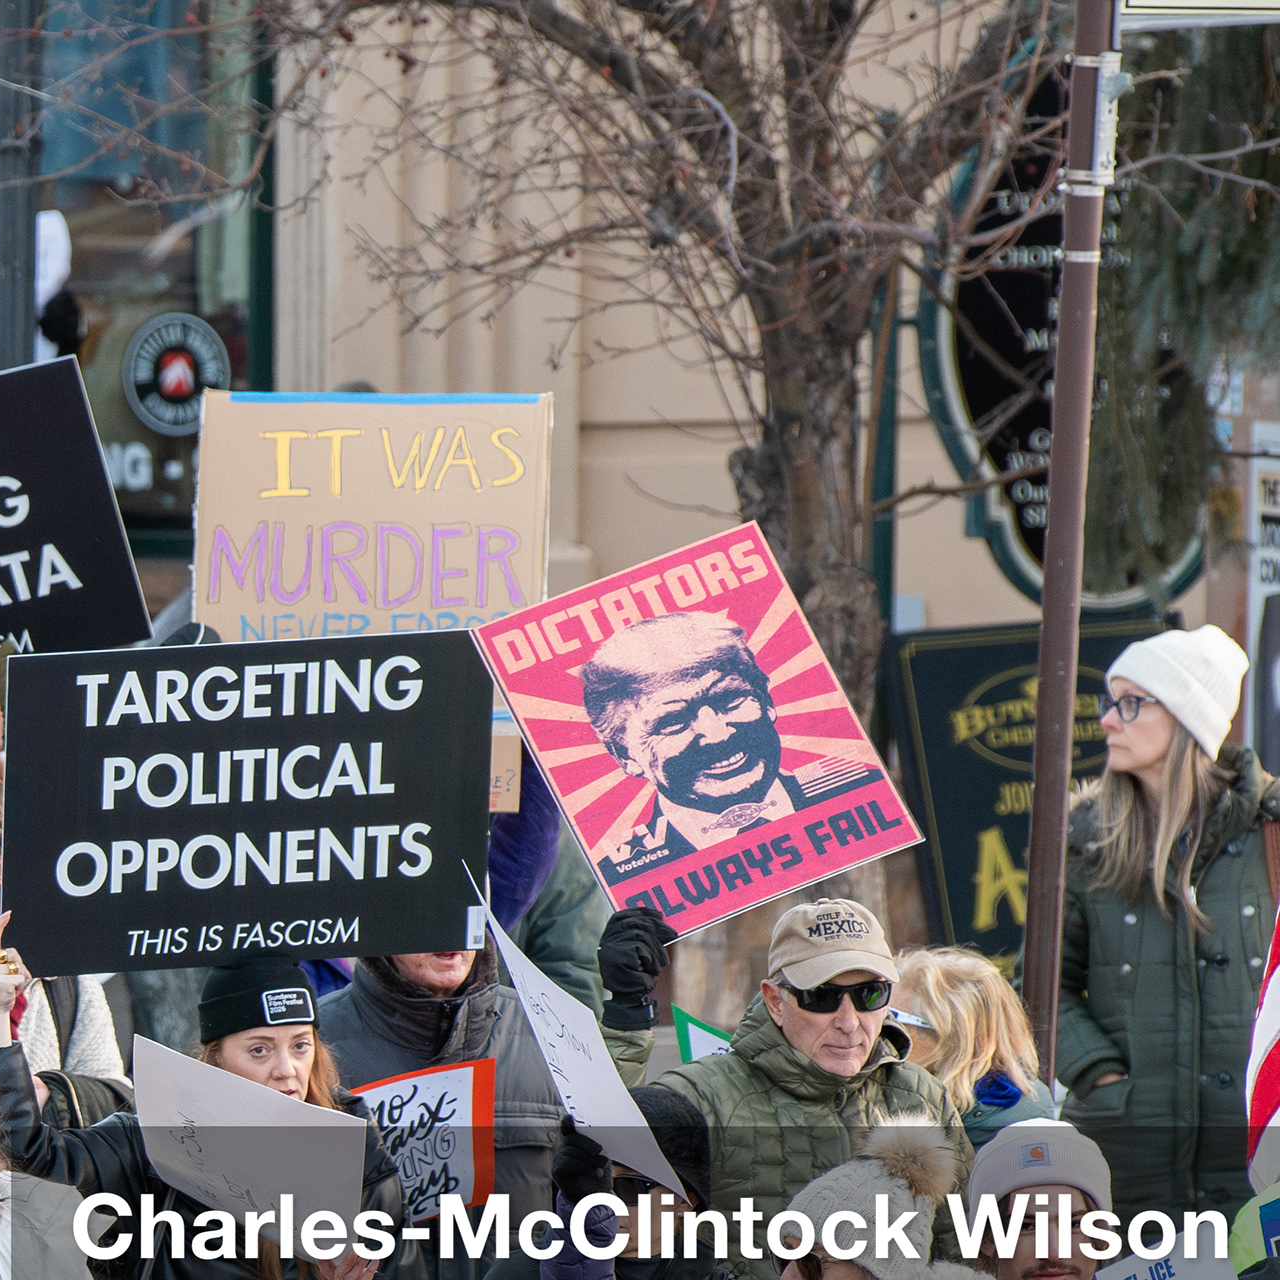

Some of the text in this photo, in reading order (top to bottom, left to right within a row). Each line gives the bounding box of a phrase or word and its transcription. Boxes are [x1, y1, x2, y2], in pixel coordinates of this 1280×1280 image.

[259, 427, 525, 499] IT WAS
[207, 519, 527, 609] MURDER
[496, 539, 769, 676] DICTATORS
[77, 655, 423, 727] TARGETING
[102, 742, 395, 811] POLITICAL
[56, 821, 432, 897] OPPONENTS
[616, 848, 670, 873] VoteVets
[625, 833, 805, 918] ALWAYS
[809, 799, 903, 862] FAIL
[128, 917, 361, 957] THIS IS FASCISM
[808, 920, 869, 937] MEXICO
[816, 912, 840, 921] GULF
